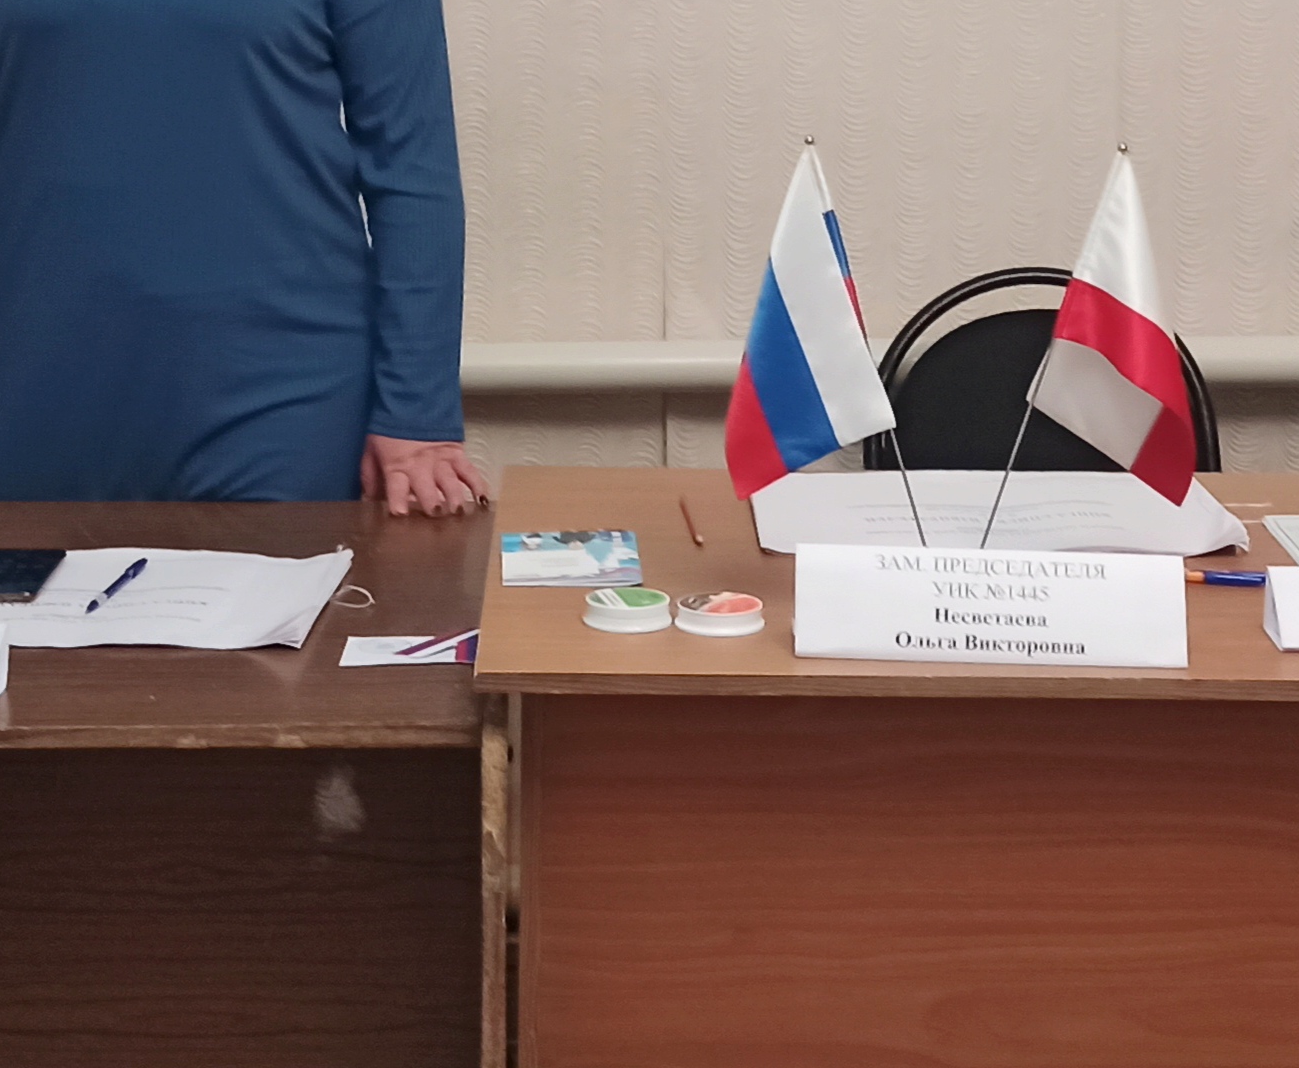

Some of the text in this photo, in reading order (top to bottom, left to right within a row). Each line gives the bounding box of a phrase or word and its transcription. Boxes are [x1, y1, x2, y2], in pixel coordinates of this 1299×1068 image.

[875, 553, 1108, 580] ЗАМ. ПРЕДСЕДАТЕЛЯ
[931, 580, 1051, 602] УИК №1445
[934, 607, 1049, 628] Несветаева
[895, 631, 1087, 658] Ольга Викторовна
